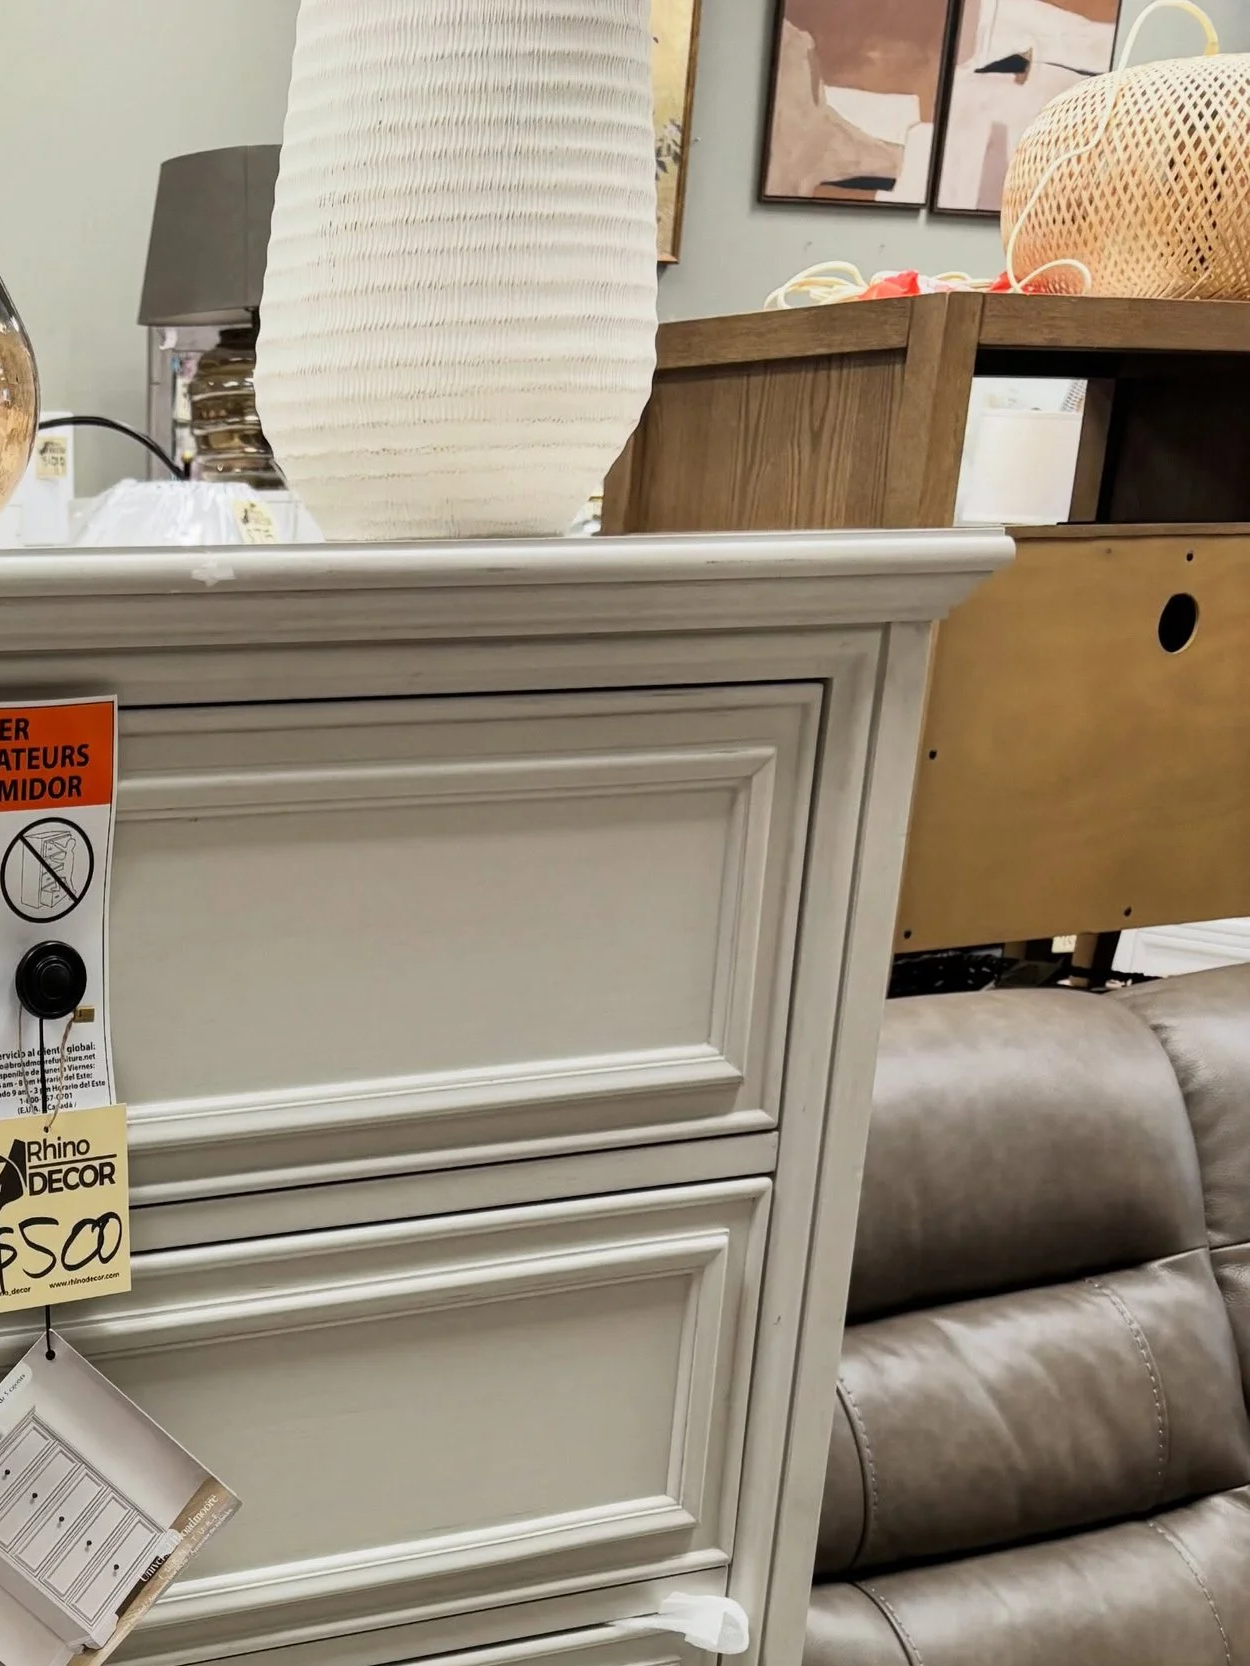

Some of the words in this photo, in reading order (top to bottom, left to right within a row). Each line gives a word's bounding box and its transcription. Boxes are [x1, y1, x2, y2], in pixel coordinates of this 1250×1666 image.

[67, 1042, 95, 1053] global:
[28, 1137, 90, 1162] Rhino
[29, 1162, 116, 1196] DECOR
[49, 1273, 119, 1288] www.rhinodecor.com
